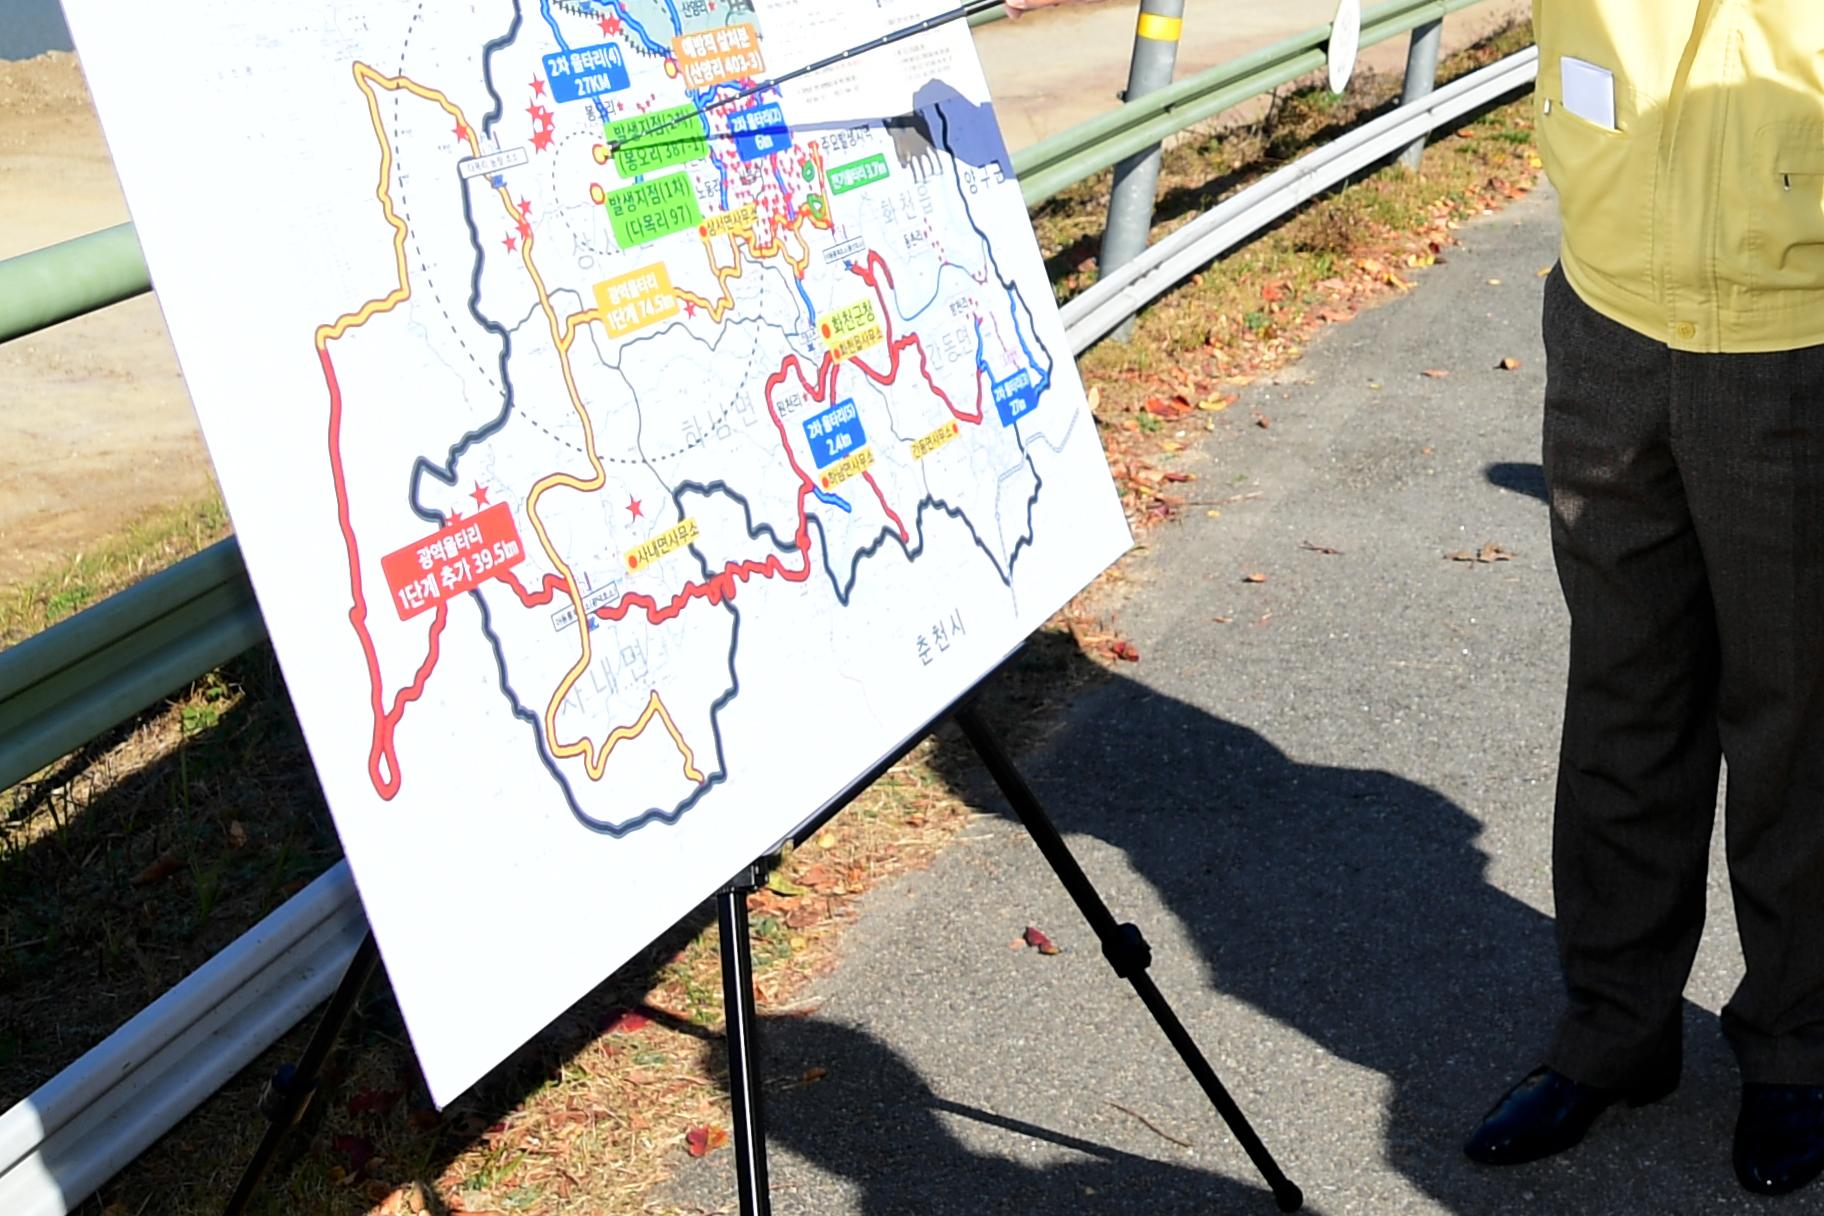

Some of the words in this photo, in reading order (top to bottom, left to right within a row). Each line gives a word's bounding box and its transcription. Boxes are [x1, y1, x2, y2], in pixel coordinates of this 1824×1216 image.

[548, 56, 568, 76] 2차
[570, 46, 622, 74] 울타리(4)
[608, 175, 691, 217] 발생지점(1차)
[624, 212, 670, 243] (다목리
[670, 203, 693, 230] 97)
[831, 299, 876, 334] 화천군청
[416, 523, 484, 570] 광역울타리
[637, 522, 701, 563] 사내면사무소
[398, 572, 440, 610] 1단계
[441, 557, 472, 591] 추가
[916, 607, 967, 667] 춘천시
